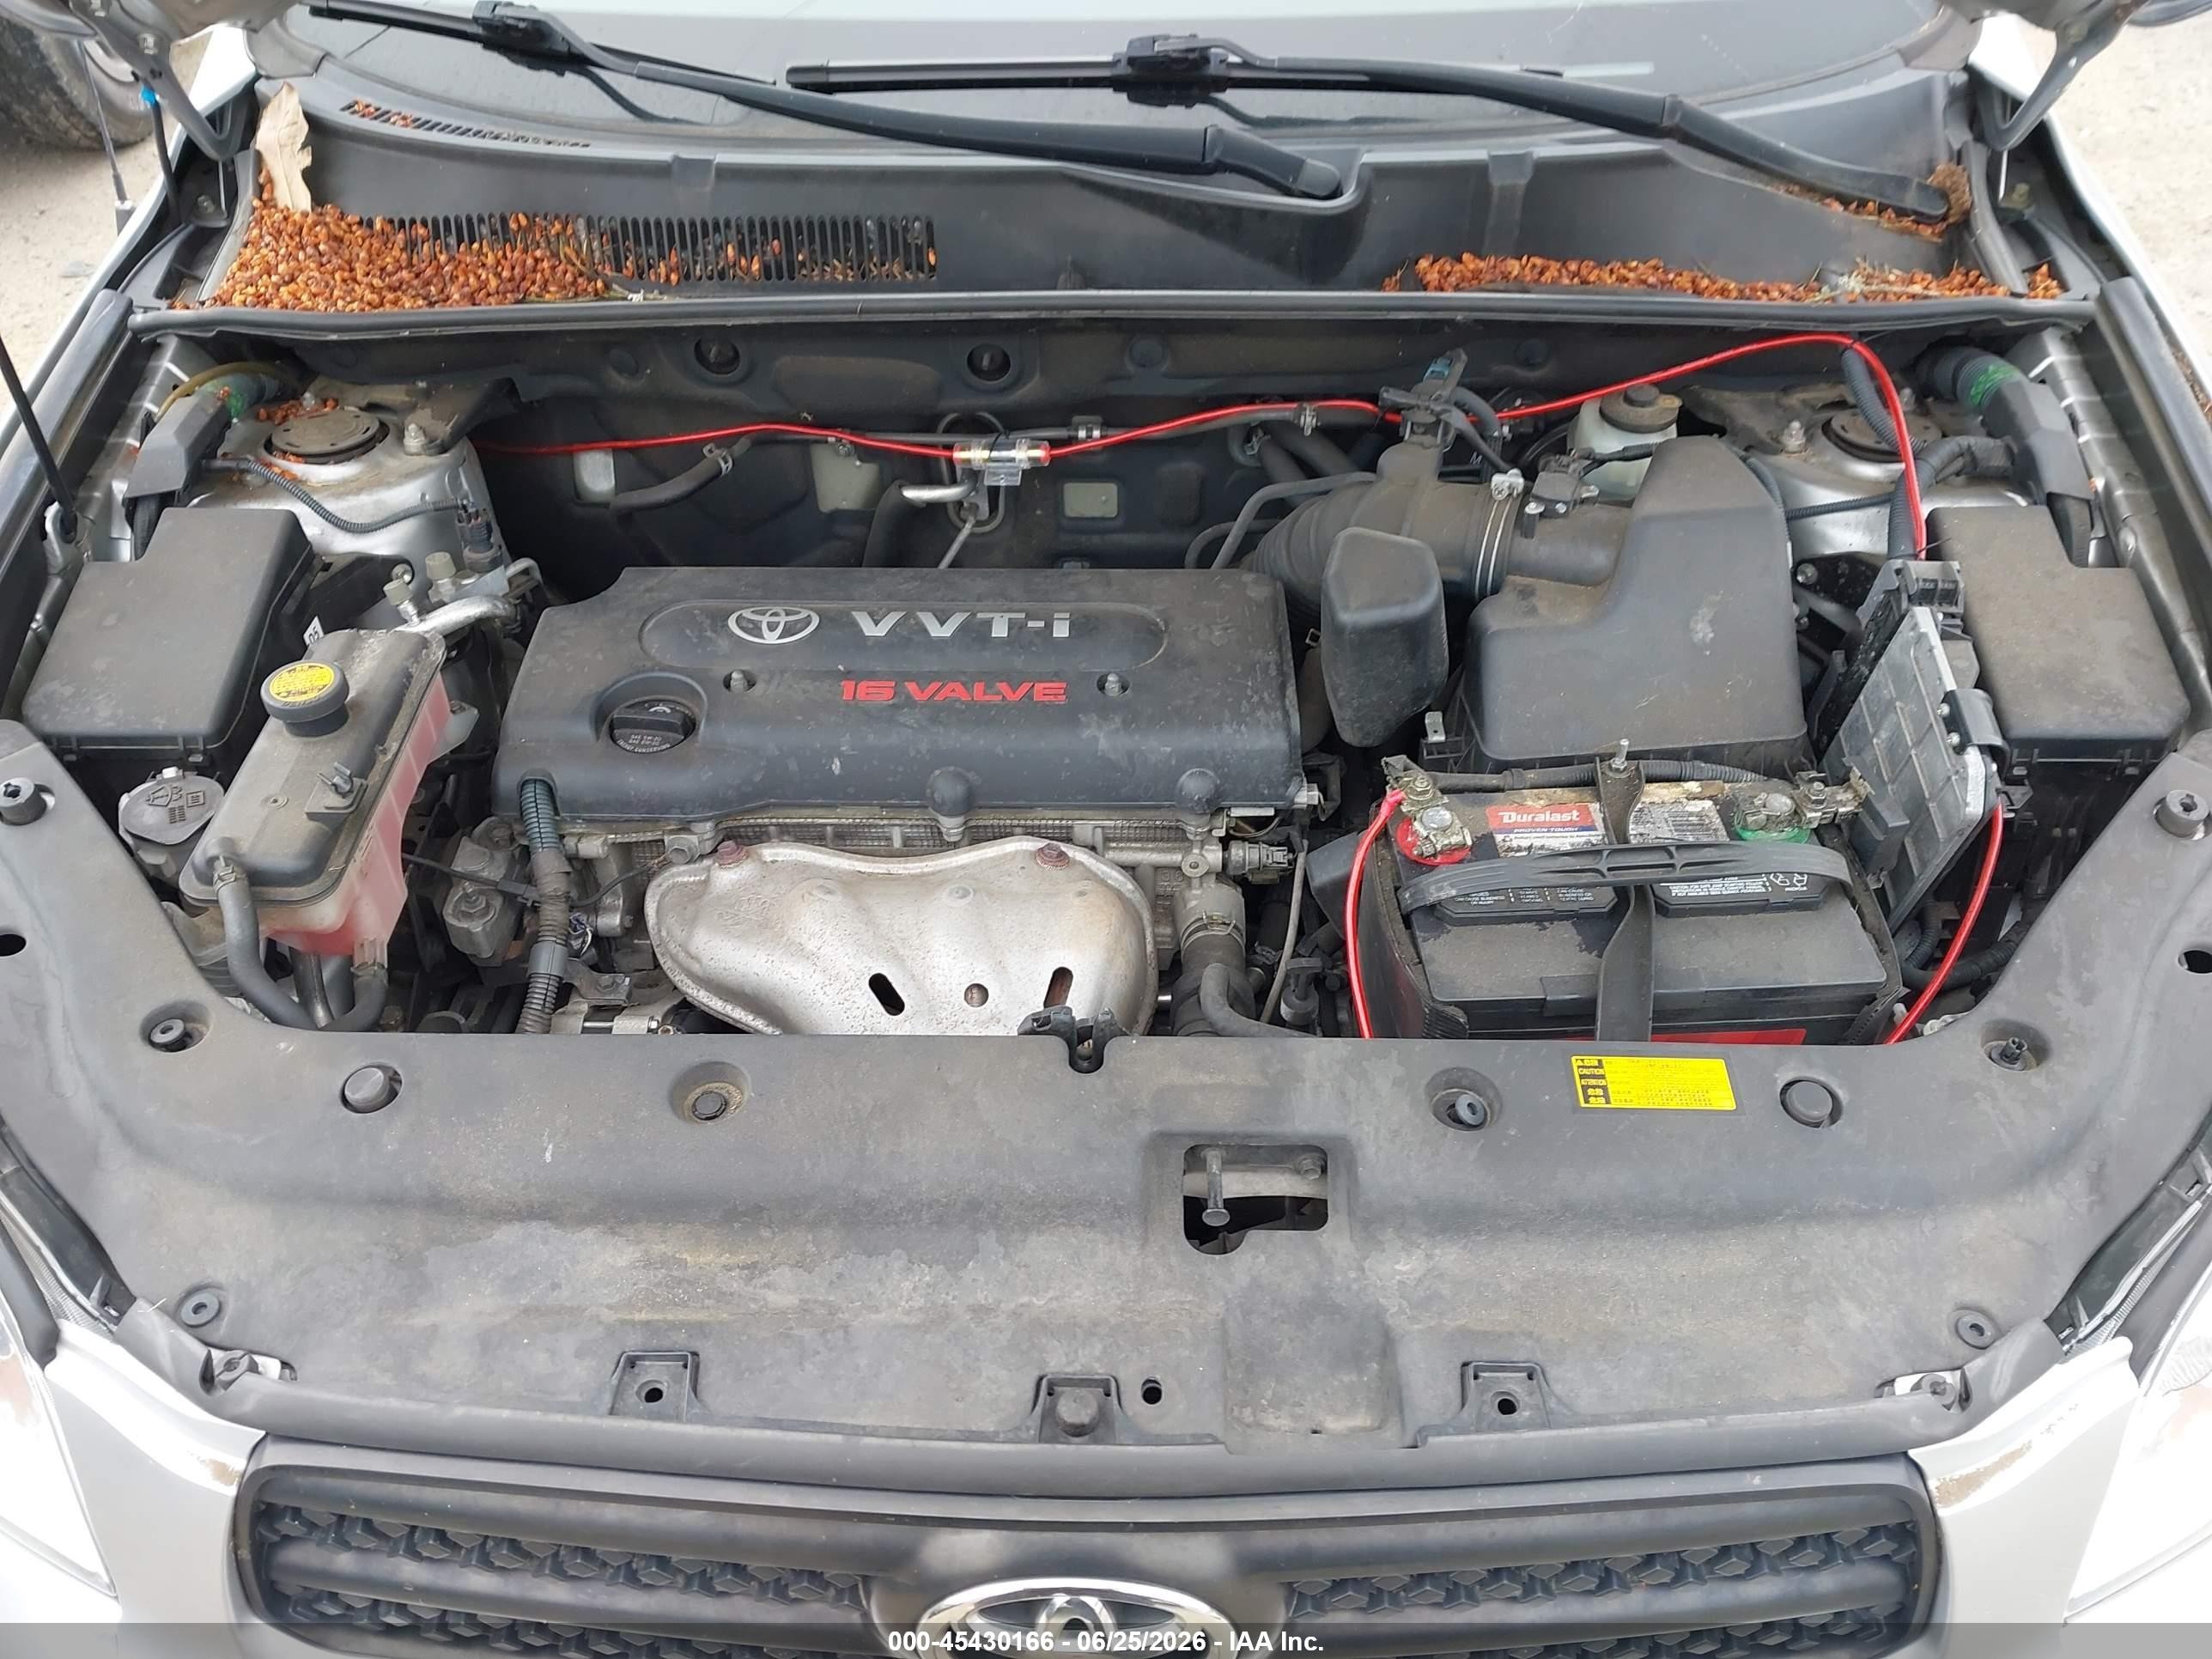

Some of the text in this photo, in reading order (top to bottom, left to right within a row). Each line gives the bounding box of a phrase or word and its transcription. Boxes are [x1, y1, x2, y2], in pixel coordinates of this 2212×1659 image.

[851, 611, 1071, 638] VVT-i
[841, 680, 1068, 702] 16 VALVE
[1497, 810, 1581, 823] Duralast
